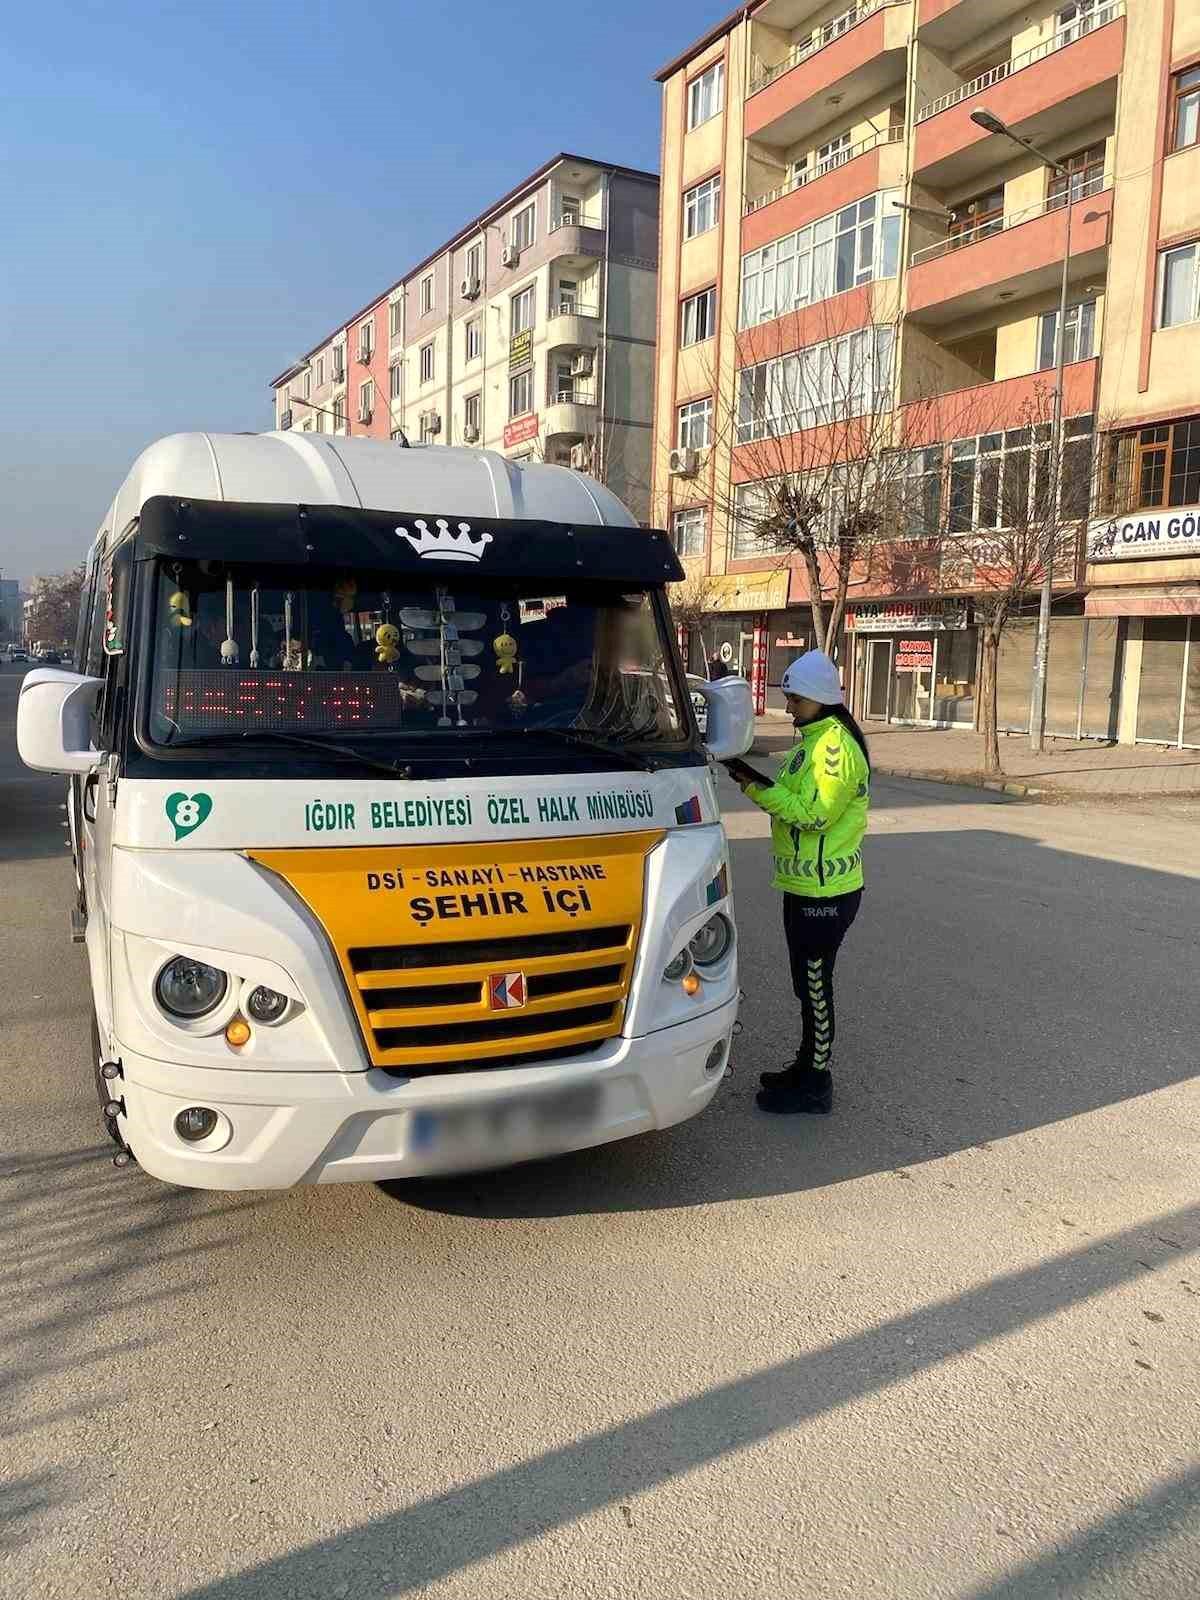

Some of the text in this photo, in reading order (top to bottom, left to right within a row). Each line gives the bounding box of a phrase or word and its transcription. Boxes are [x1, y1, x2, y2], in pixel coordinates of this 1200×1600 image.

[1122, 512, 1200, 544] CAN GÖ
[175, 800, 200, 827] 8
[305, 791, 654, 832] IĞDIR BELEDİYESİ ÖZEL HALK MİNİBÜSÜ
[367, 868, 405, 890] DSİ
[426, 864, 505, 888] SANAYİ
[519, 864, 607, 883] HASTANE
[409, 885, 592, 927] ŞEHİR İÇİ
